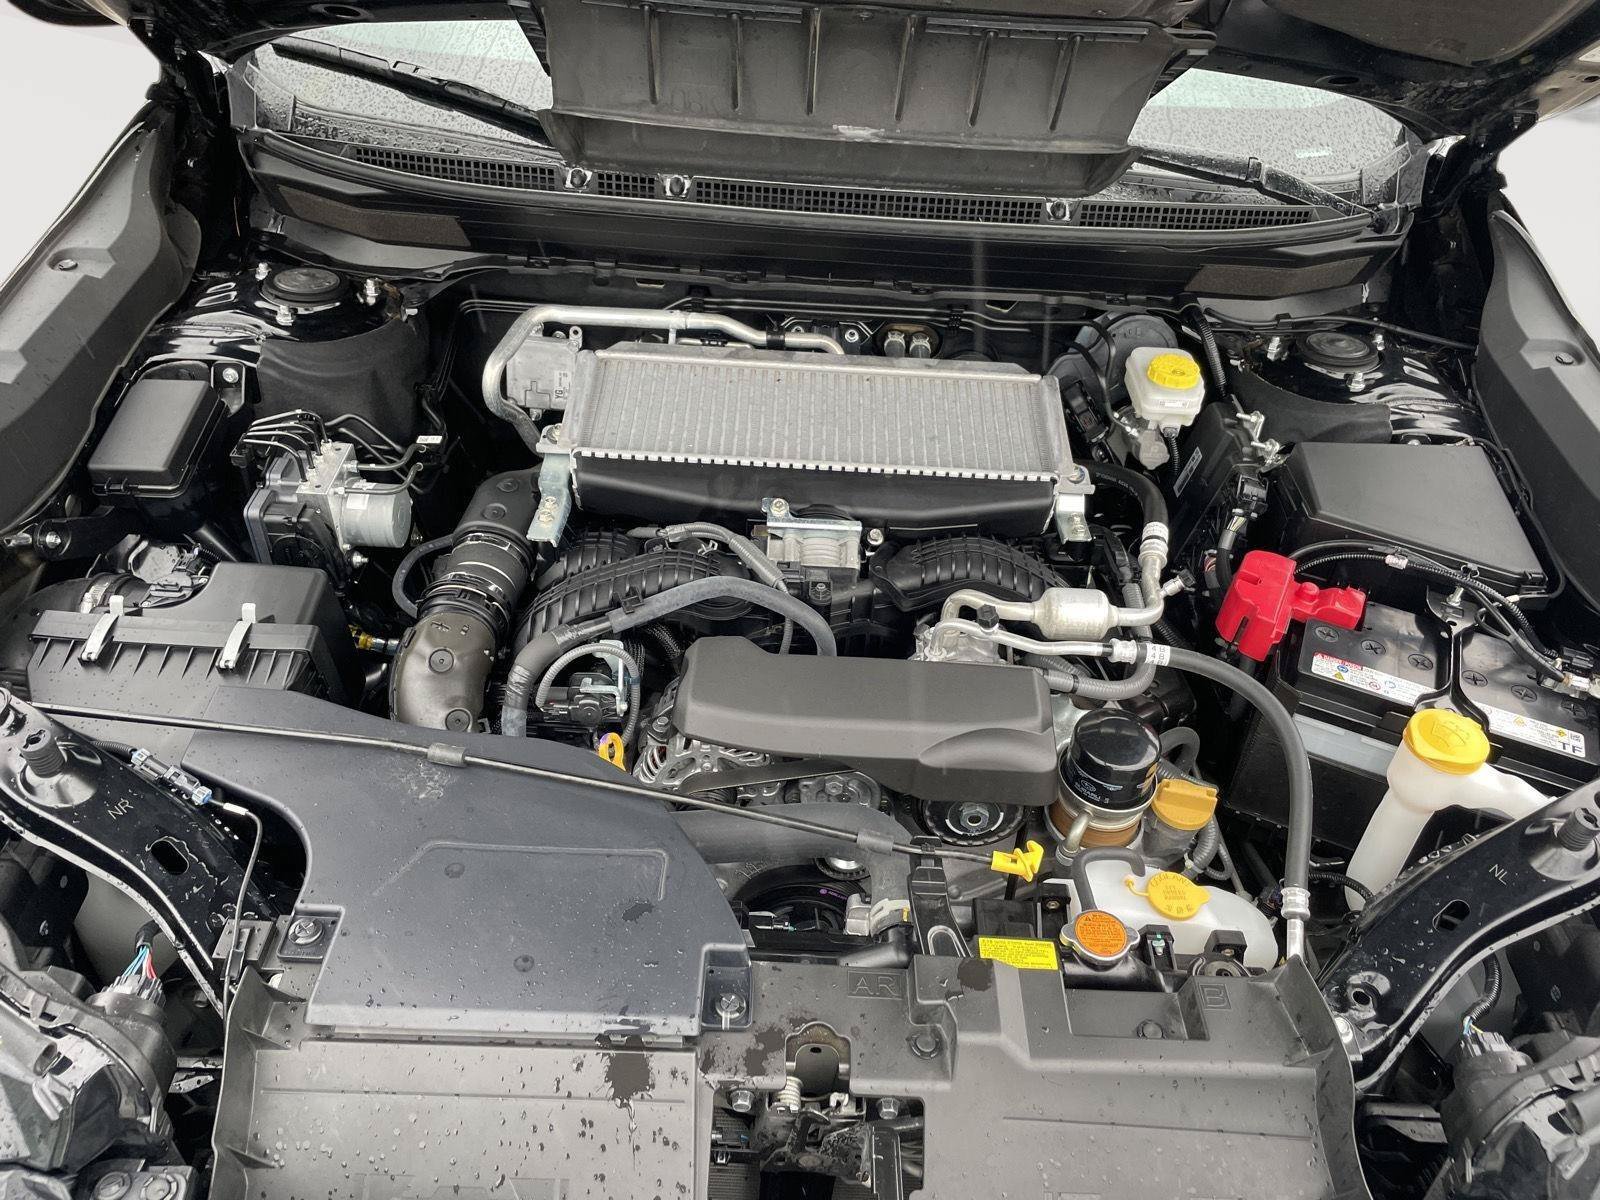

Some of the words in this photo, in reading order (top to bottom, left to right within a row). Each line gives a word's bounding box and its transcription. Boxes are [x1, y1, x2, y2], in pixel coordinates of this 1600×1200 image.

[1559, 740, 1583, 754] TF
[108, 799, 134, 820] NR
[1488, 863, 1508, 886] NL
[851, 976, 902, 997] AR
